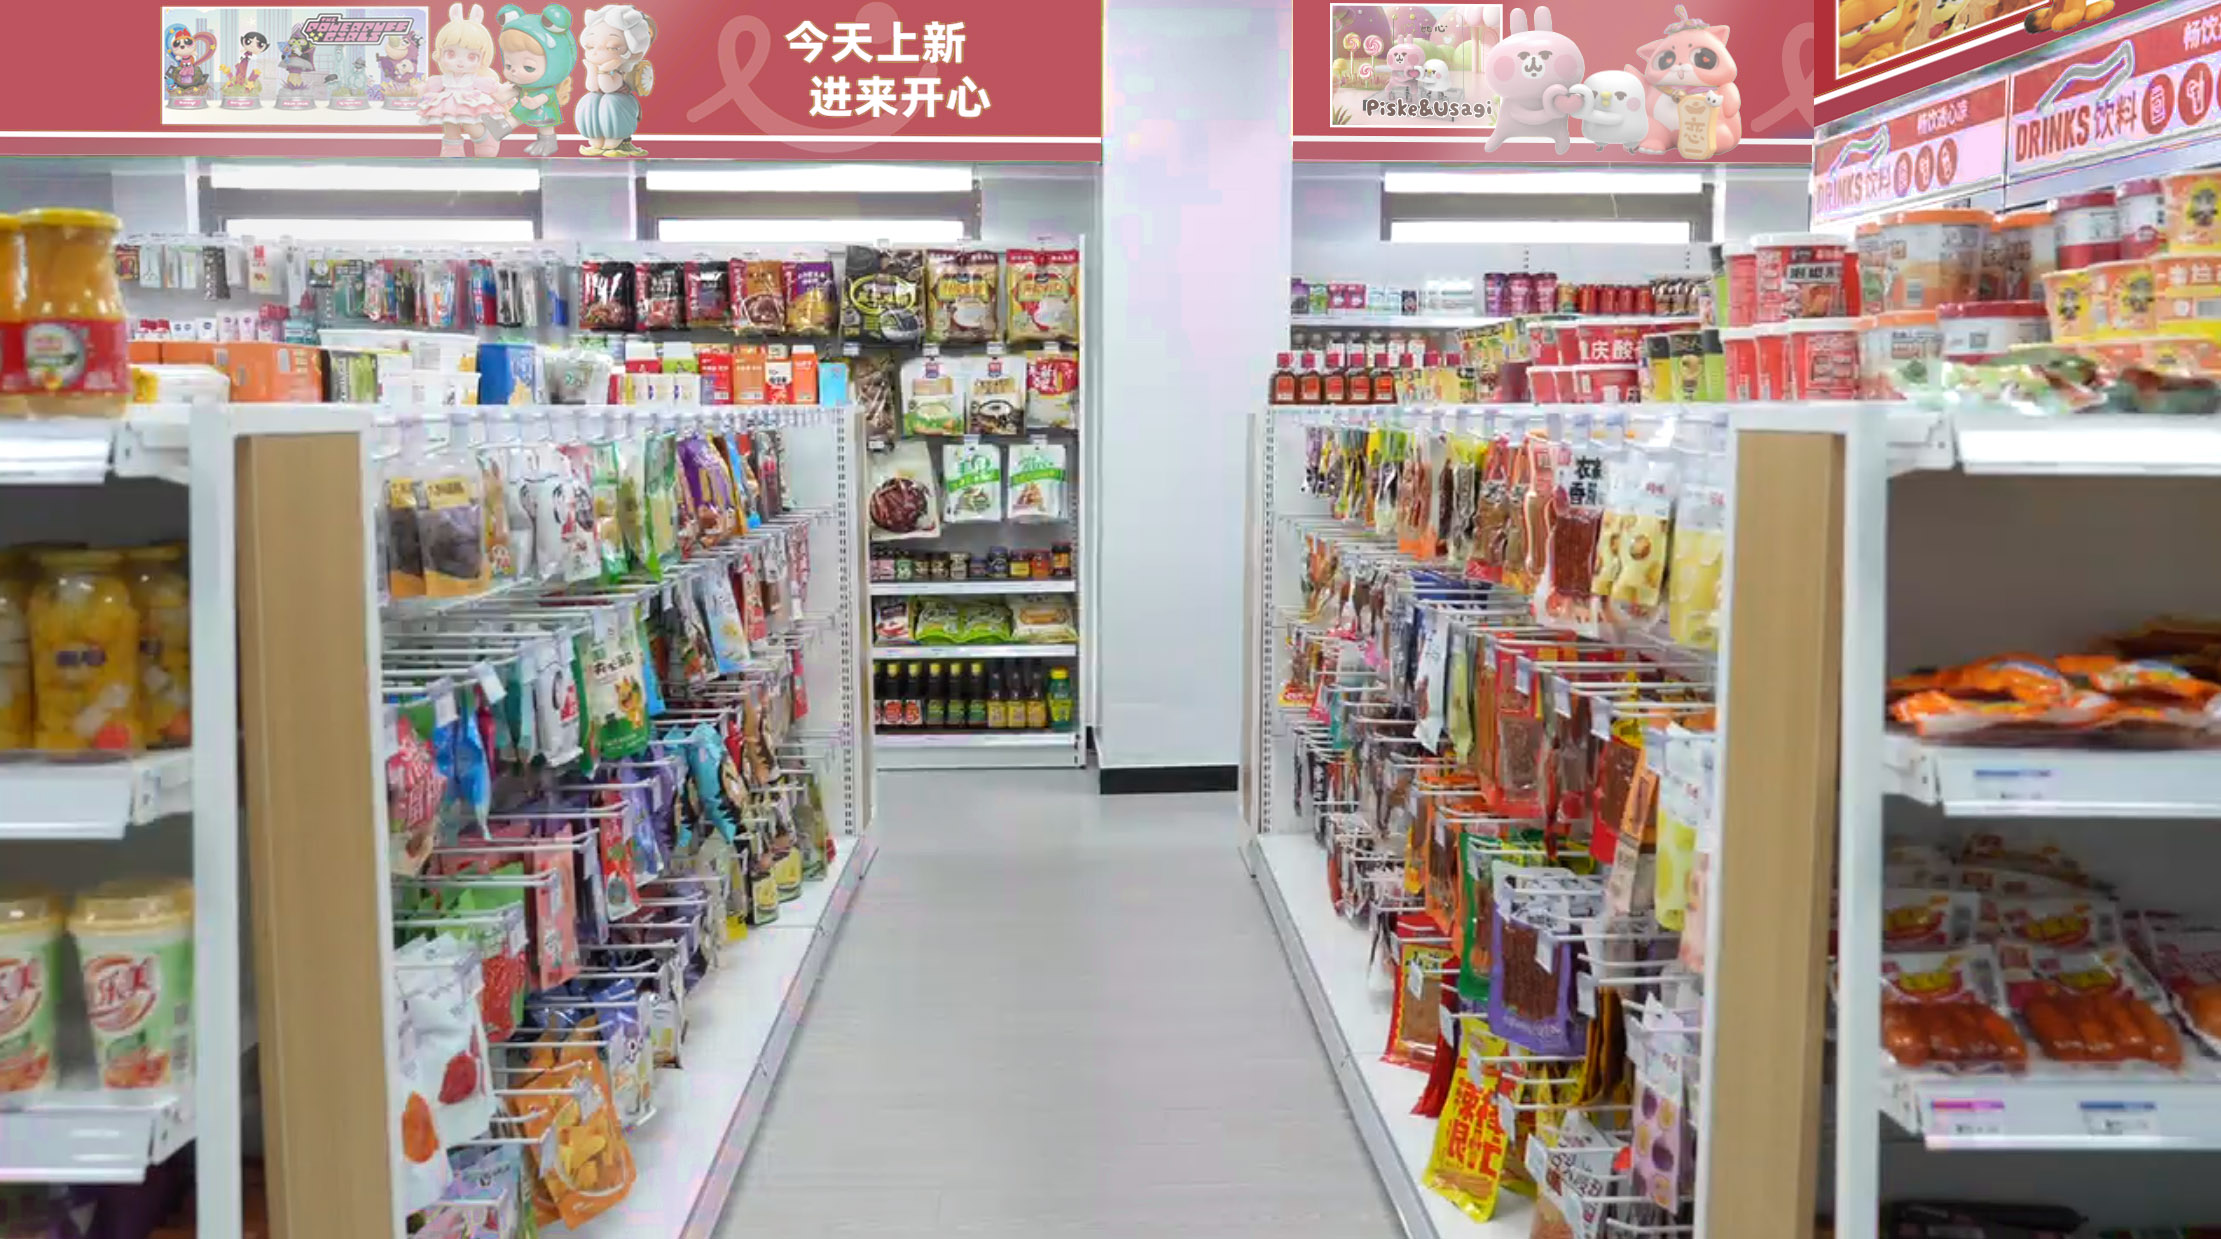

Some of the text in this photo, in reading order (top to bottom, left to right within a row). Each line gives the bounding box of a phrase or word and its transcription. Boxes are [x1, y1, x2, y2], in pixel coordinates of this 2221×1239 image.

[306, 22, 409, 32] POWERPUFF
[323, 32, 381, 42] GIRLS
[784, 20, 966, 64] 今天上新
[2182, 14, 2221, 52] 畅饮
[808, 75, 992, 118] 进来开心
[1366, 98, 1493, 119] Piske&Usagi
[2015, 90, 2138, 162] DRINKS 饮料
[1816, 171, 1863, 214] DRINKS
